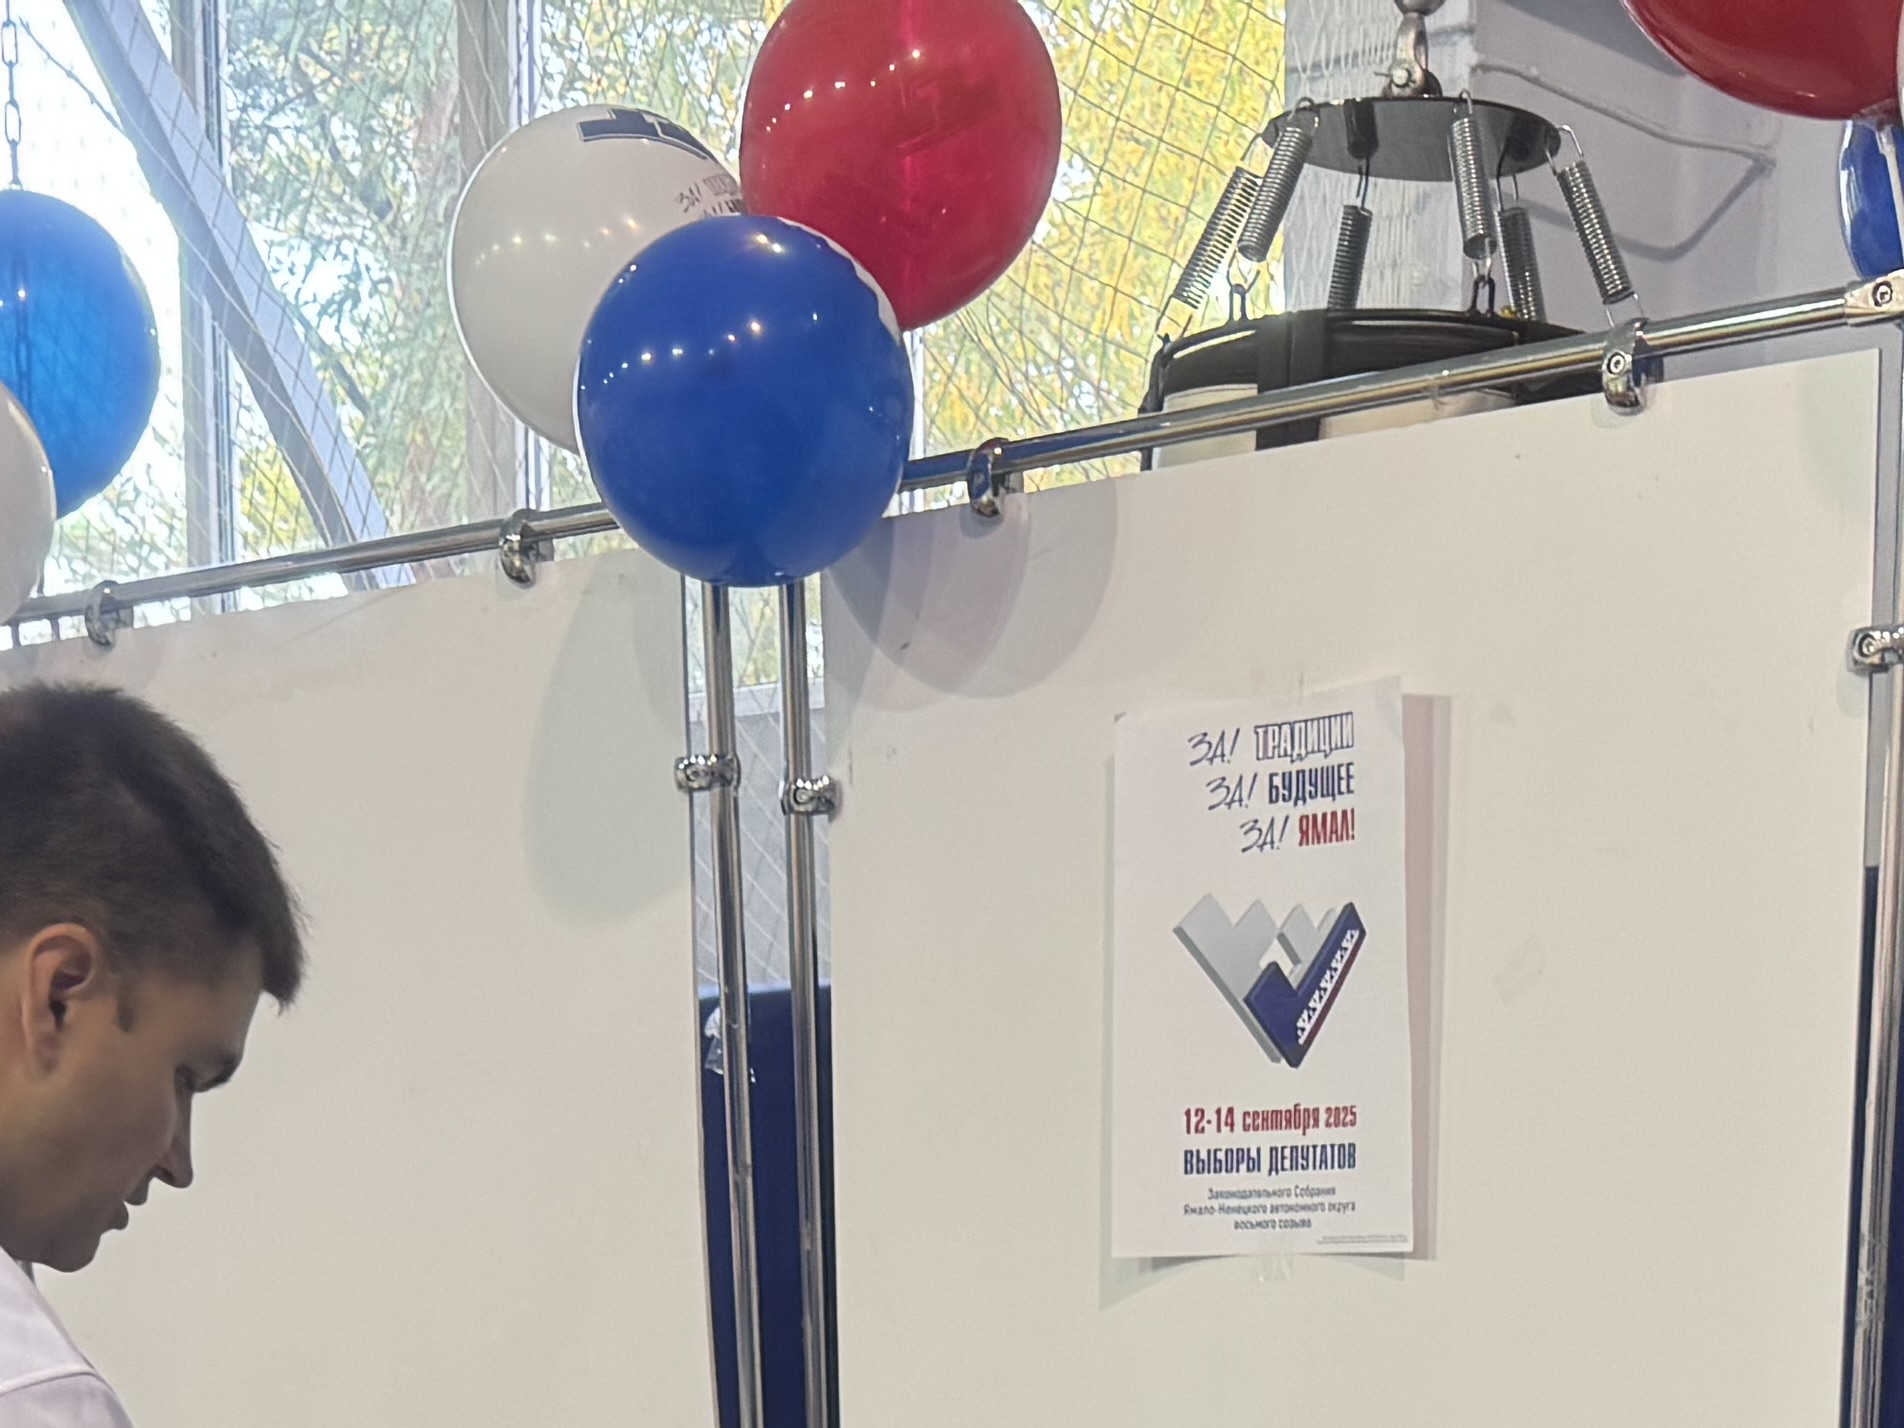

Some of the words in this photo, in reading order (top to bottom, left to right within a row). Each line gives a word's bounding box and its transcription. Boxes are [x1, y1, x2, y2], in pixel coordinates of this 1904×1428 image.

[1188, 727, 1241, 766] ЗА!
[1254, 711, 1355, 763] ТРАДИЦИИ
[1206, 772, 1258, 811] ЗА!
[1268, 762, 1355, 807] БУДУЩЕЕ
[1240, 814, 1290, 853] ЗА!
[1298, 807, 1355, 847] ЯМАЛ!
[1184, 1106, 1235, 1135] 12-14
[1242, 1103, 1320, 1136] сентября
[1325, 1105, 1357, 1128] 2025
[1183, 1146, 1261, 1176] ВЫБОРЫ
[1268, 1142, 1357, 1177] ДЕПУТАТОВ
